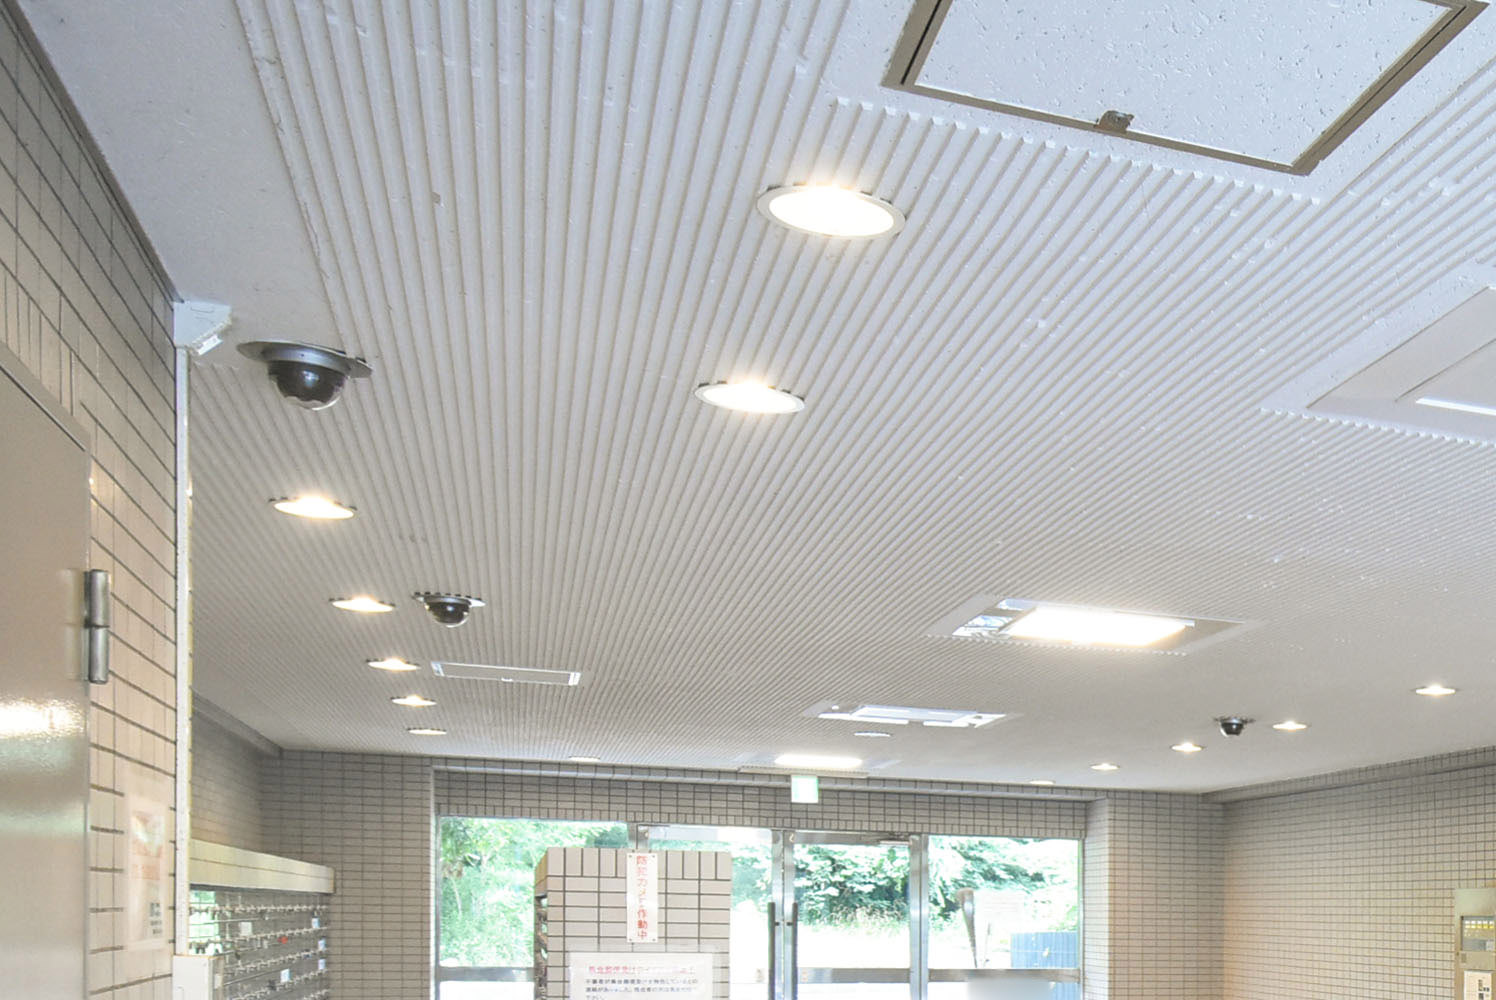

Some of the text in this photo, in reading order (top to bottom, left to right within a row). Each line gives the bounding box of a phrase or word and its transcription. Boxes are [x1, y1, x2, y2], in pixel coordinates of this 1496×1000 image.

[636, 855, 649, 939] 防犯カメ作動中
